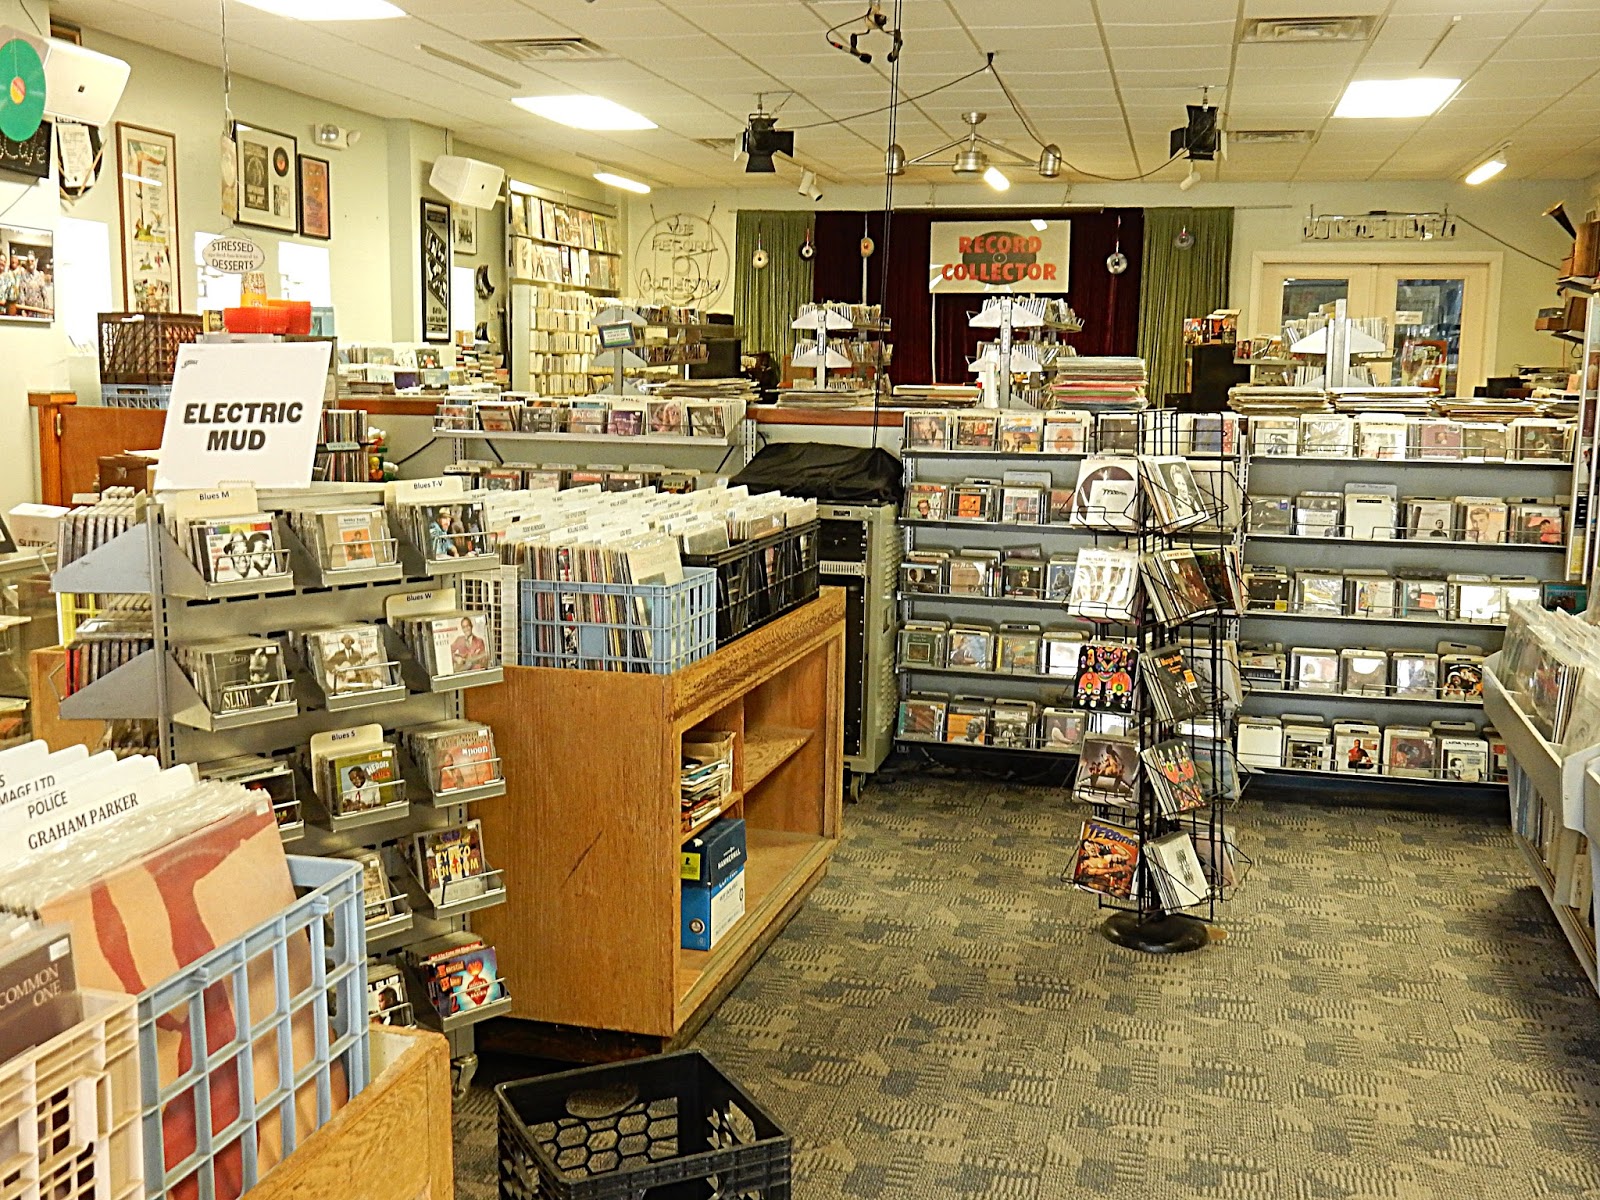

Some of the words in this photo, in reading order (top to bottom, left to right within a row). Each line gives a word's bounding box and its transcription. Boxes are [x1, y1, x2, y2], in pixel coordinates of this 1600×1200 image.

[212, 240, 254, 253] STRESSED
[958, 235, 1042, 254] RECORD
[211, 258, 254, 271] DESSERTS
[941, 262, 1057, 281] COLLECTOR
[184, 402, 303, 424] ELECTRIC
[206, 430, 266, 451] MUD
[413, 481, 431, 490] Blues
[432, 480, 443, 488] T-V
[199, 492, 220, 501] Blues
[221, 490, 230, 499] M
[406, 594, 424, 602] Blues
[425, 592, 432, 600] W
[223, 689, 250, 709] SLIM
[331, 731, 350, 741] Blues
[351, 729, 356, 738] S
[27, 790, 69, 819] POLICE
[27, 811, 88, 850] GRAHAM
[90, 791, 140, 825] PARKER
[0, 962, 59, 1010] COMMON
[33, 980, 62, 1007] ONE
